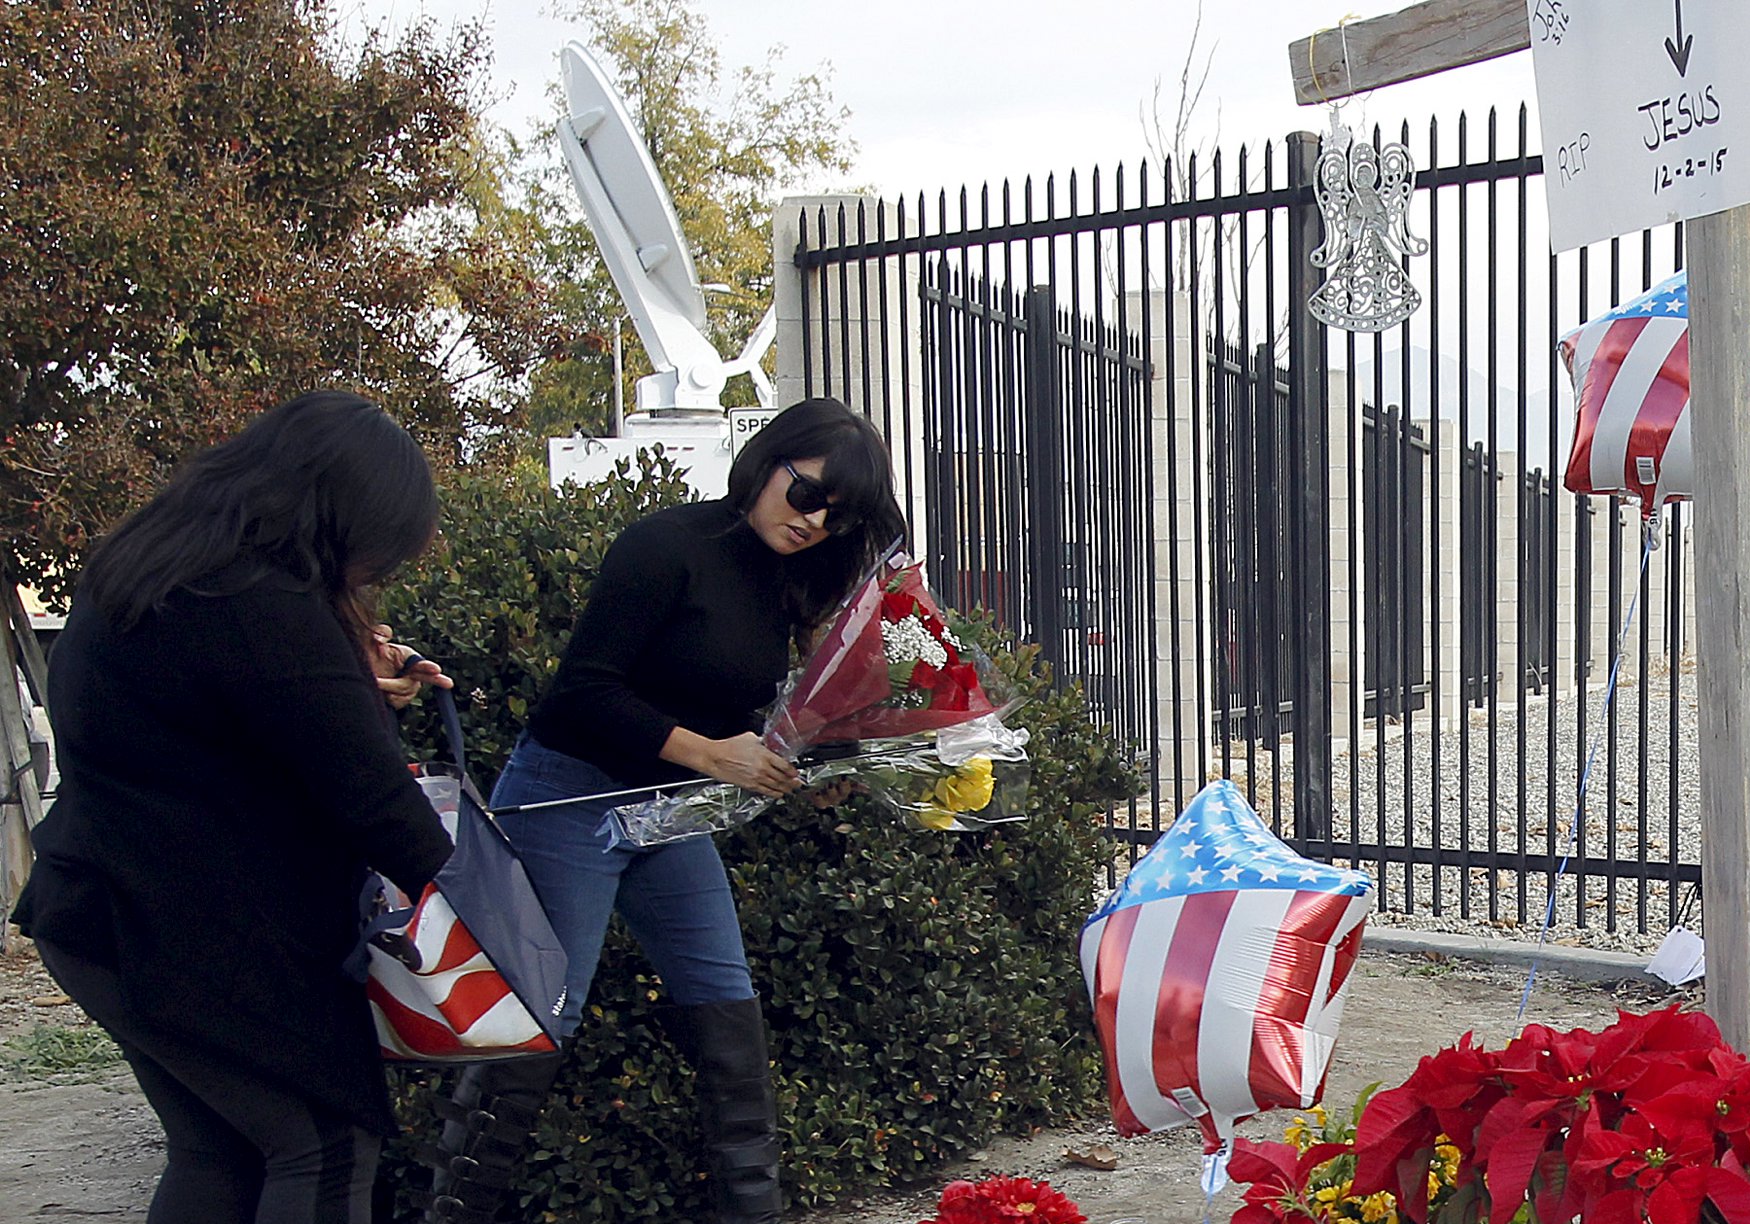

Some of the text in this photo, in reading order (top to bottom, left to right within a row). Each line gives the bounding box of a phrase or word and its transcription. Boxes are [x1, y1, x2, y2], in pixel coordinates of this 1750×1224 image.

[1532, 0, 1563, 42] Joh
[1551, 12, 1570, 46] 3:16
[1637, 84, 1722, 152] JESUS
[1556, 131, 1592, 188] RIP
[1653, 146, 1728, 195] 12-2-15
[737, 418, 771, 433] SPE
